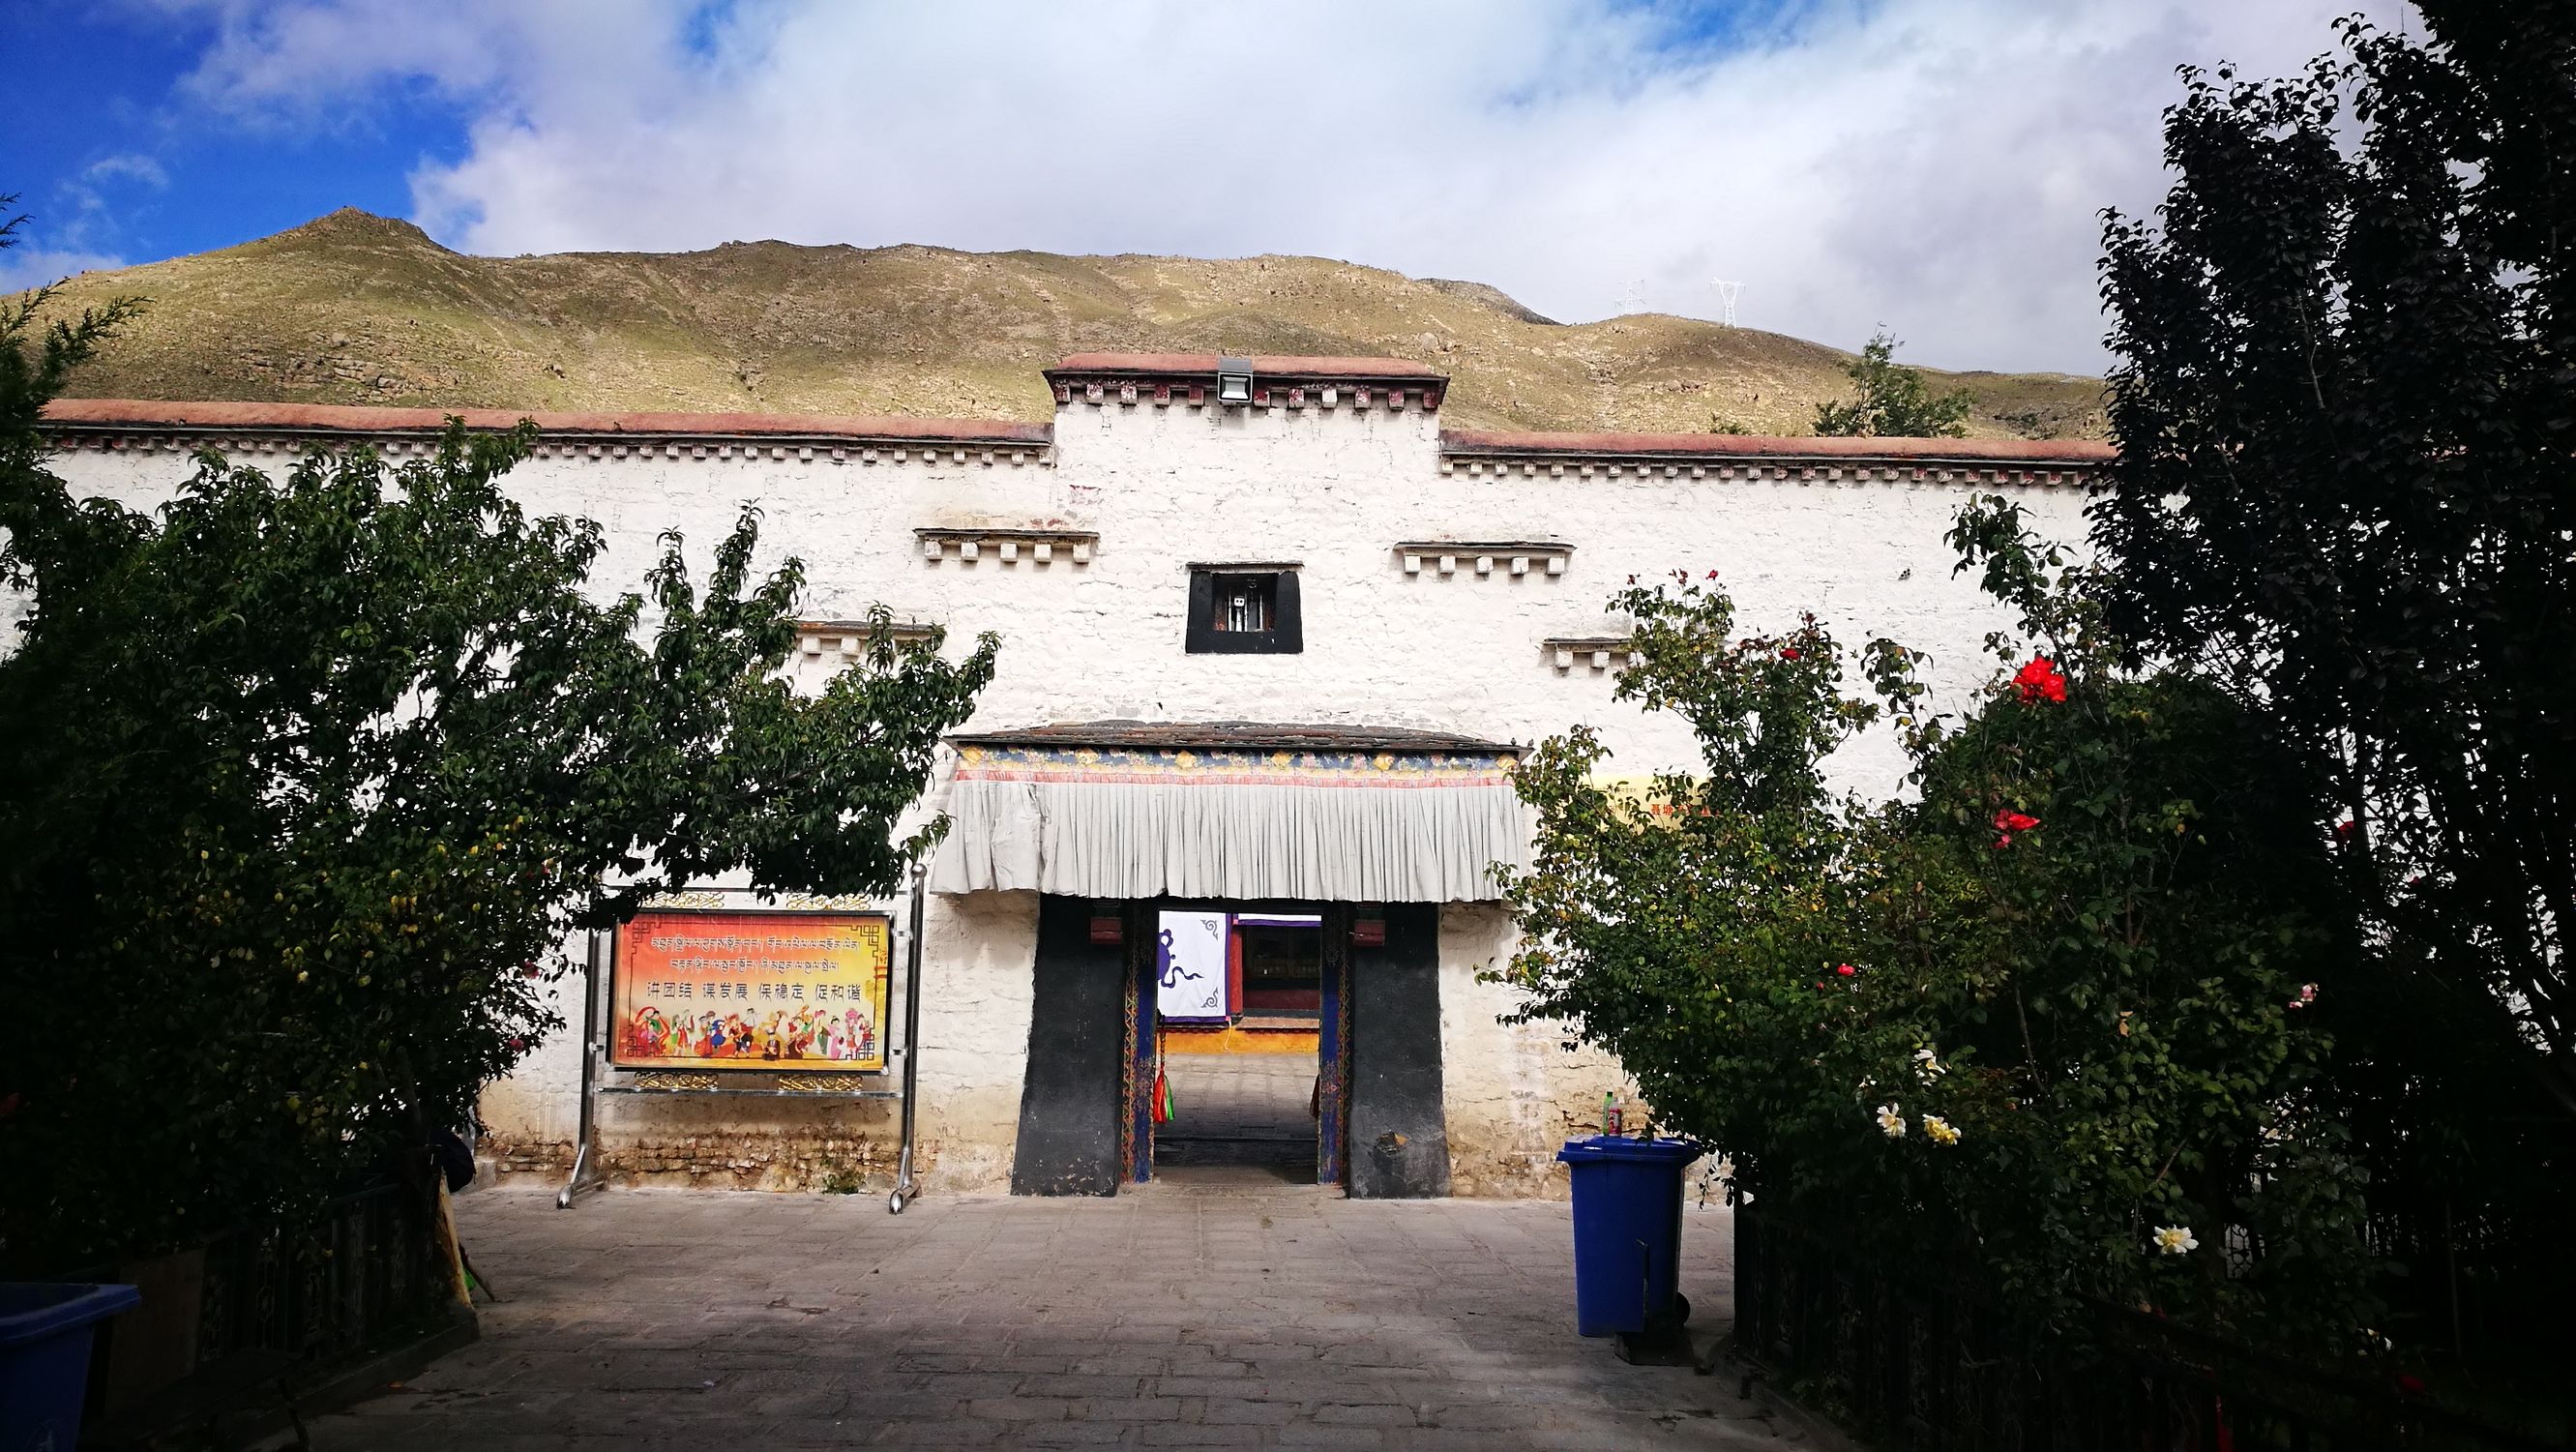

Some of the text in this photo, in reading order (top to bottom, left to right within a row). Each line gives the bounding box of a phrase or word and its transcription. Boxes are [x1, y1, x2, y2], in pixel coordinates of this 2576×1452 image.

[647, 981, 861, 1003] 讲团结 谋发展 保稳定 促和谐
